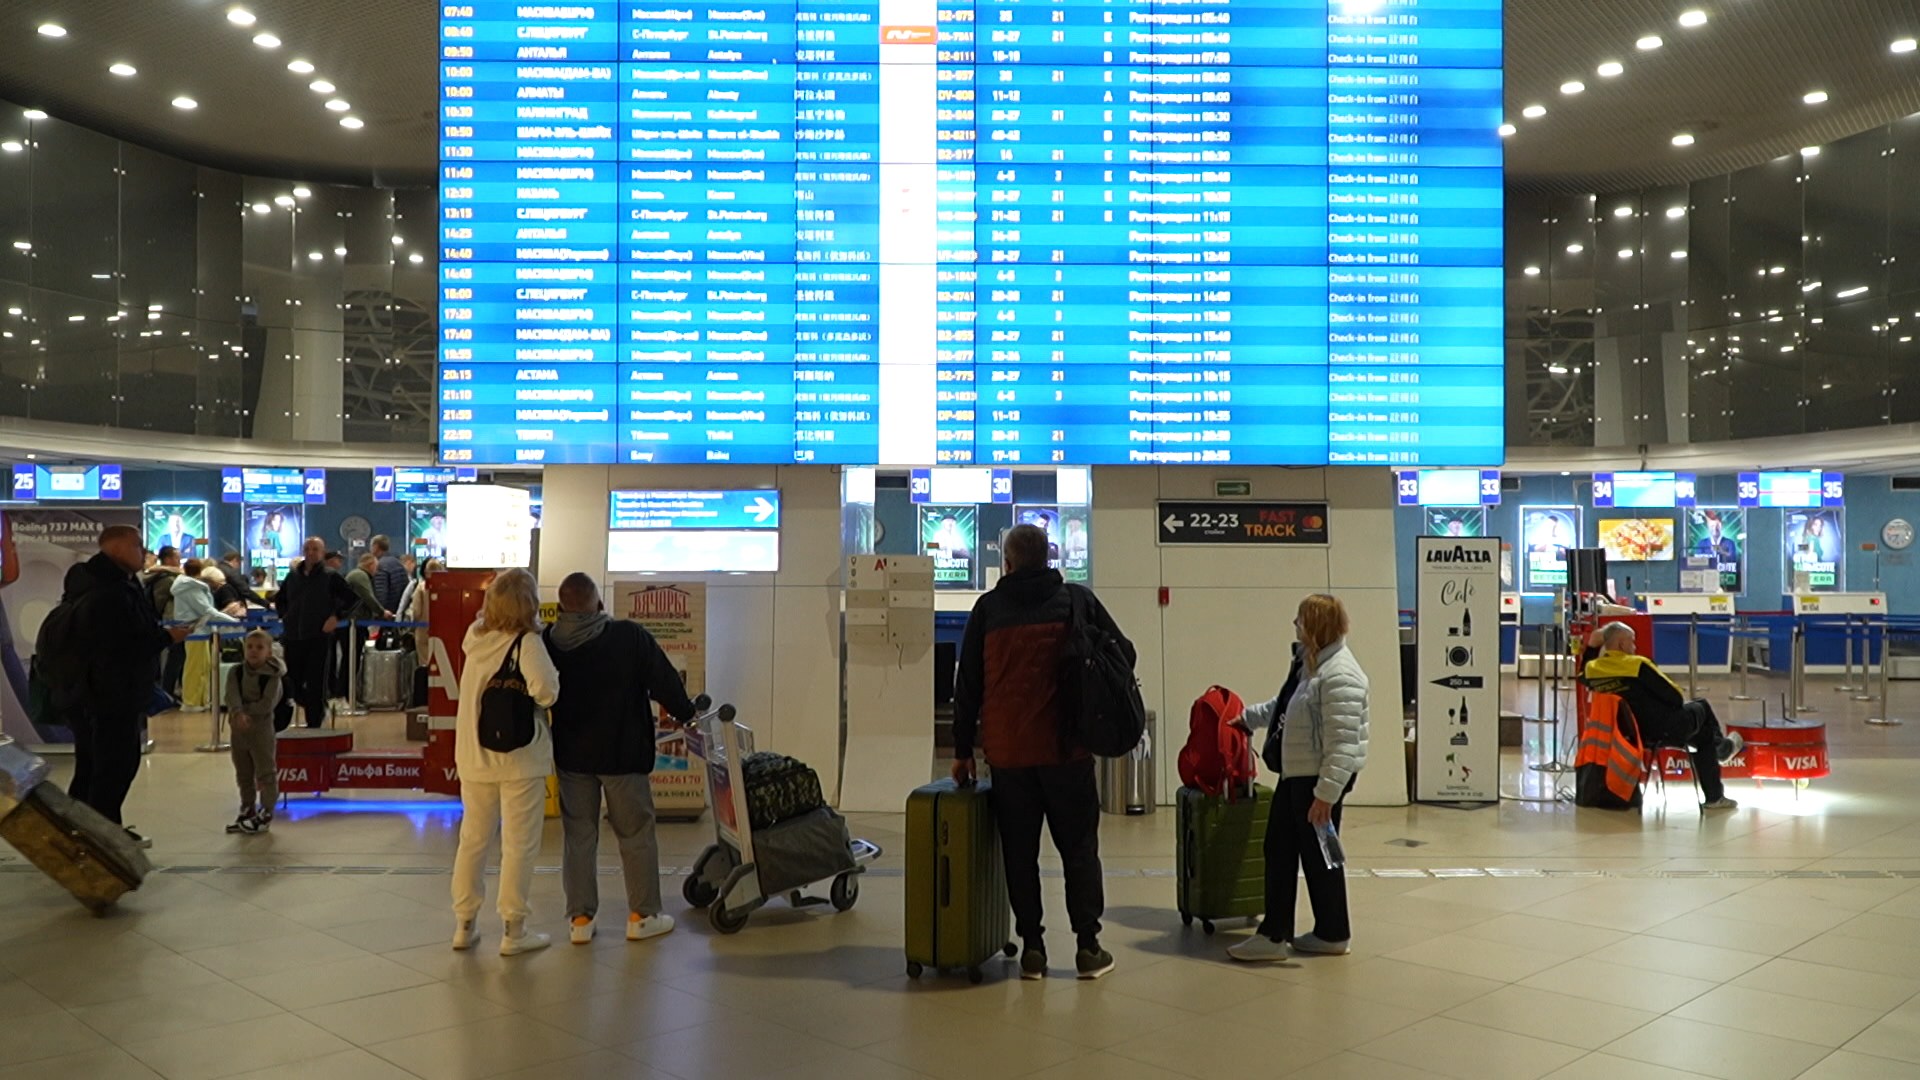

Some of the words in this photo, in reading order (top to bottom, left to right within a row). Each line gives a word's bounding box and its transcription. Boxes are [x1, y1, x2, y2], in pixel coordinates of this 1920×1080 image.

[15, 473, 33, 488] 25
[102, 473, 119, 489] 25
[223, 477, 241, 493] 26
[306, 478, 324, 494] 26
[374, 476, 393, 492] 27
[912, 478, 929, 494] 30
[993, 478, 1011, 494] 30
[1400, 479, 1417, 496] 33
[1481, 479, 1499, 496] 33
[1594, 482, 1612, 498] 34
[1739, 482, 1757, 498] 35
[1824, 482, 1842, 498] 35
[1190, 513, 1239, 527] 22-23
[1259, 510, 1296, 523] FAST
[11, 522, 48, 533] Boeing
[49, 522, 68, 531] 737
[69, 522, 95, 531] MAX
[1244, 524, 1296, 536] TRACK
[1426, 545, 1492, 563] LAVAZZA
[338, 763, 384, 777] Альфа
[385, 763, 420, 777] Банк
[1666, 756, 1691, 770] Аль
[1784, 756, 1819, 770] VISA
[275, 768, 308, 781] VISA
